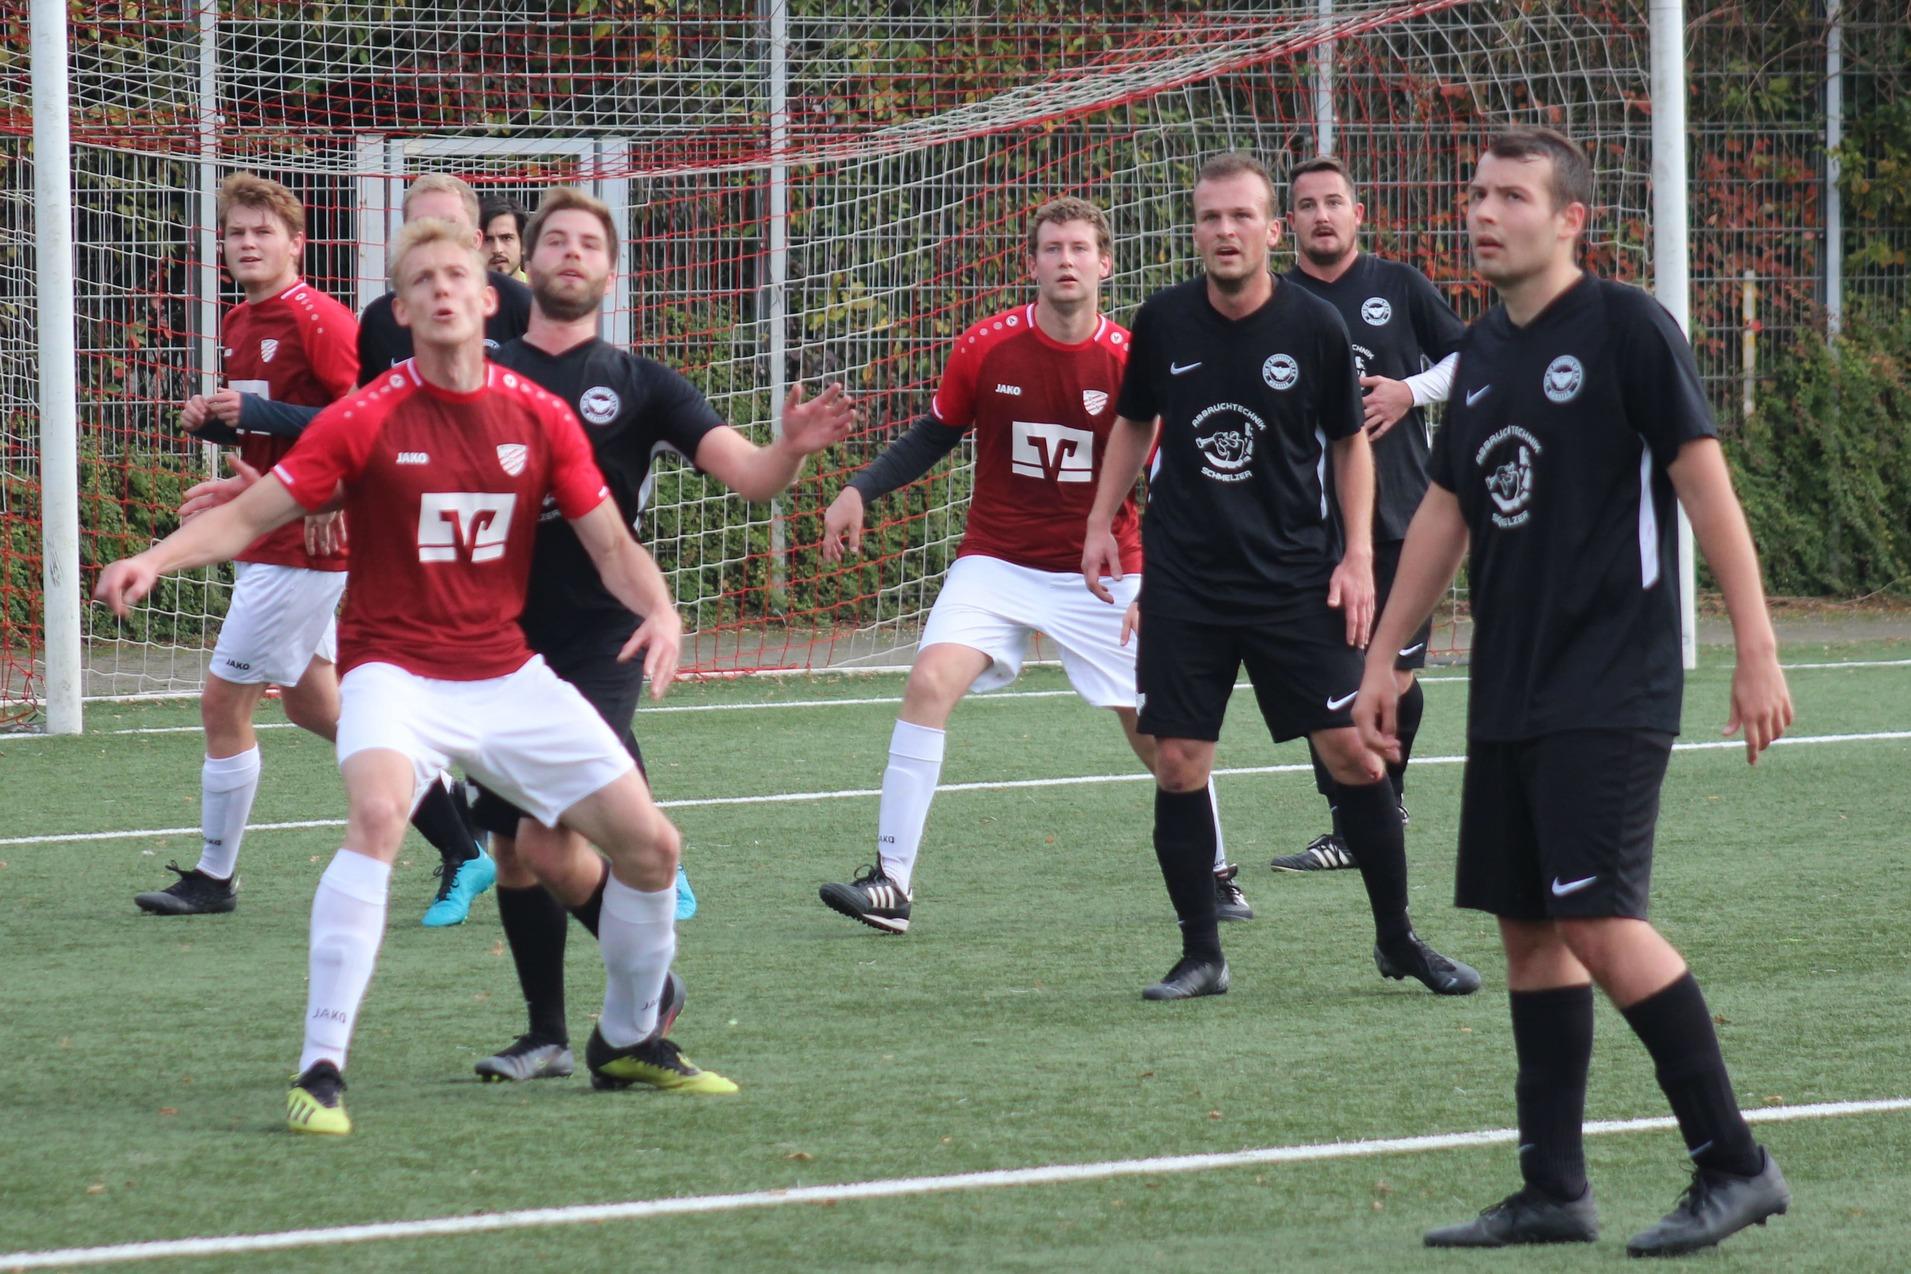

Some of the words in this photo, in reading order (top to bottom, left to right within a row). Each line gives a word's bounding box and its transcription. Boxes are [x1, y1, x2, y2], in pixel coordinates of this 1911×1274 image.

[995, 383, 1022, 396] JAKO
[1191, 402, 1267, 431] ABBRUCHTECHNIK
[396, 452, 429, 465] JAKO
[1200, 466, 1253, 482] SCHMELZER
[226, 658, 250, 671] JAKO
[312, 1007, 347, 1024] JAKO
